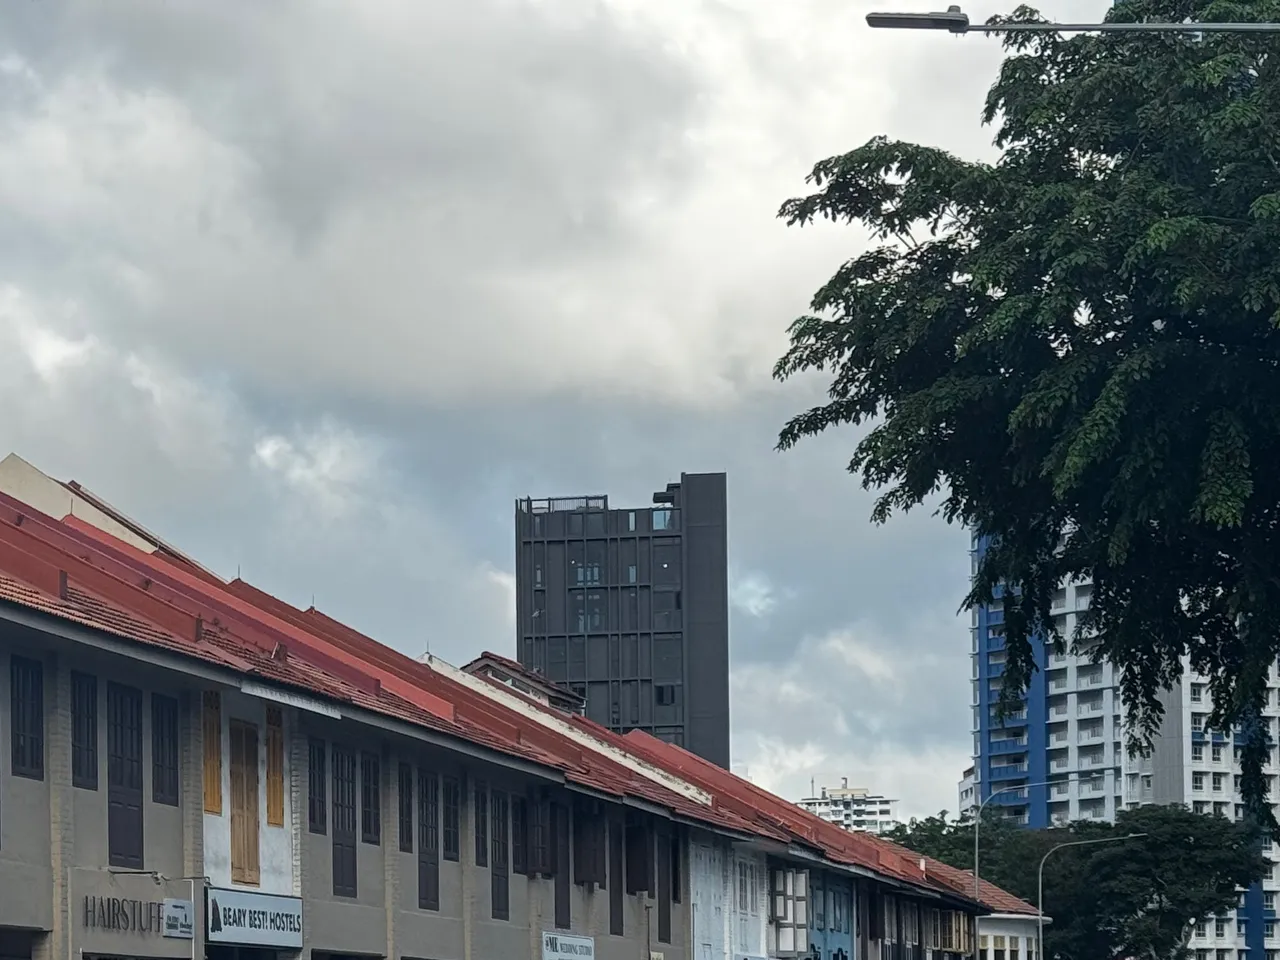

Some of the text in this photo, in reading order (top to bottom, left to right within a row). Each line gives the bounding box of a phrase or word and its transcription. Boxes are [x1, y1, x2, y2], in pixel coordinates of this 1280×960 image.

[85, 896, 164, 932] HAIRSTUFF
[223, 907, 301, 933] BEARY BEST! HOSTELS
